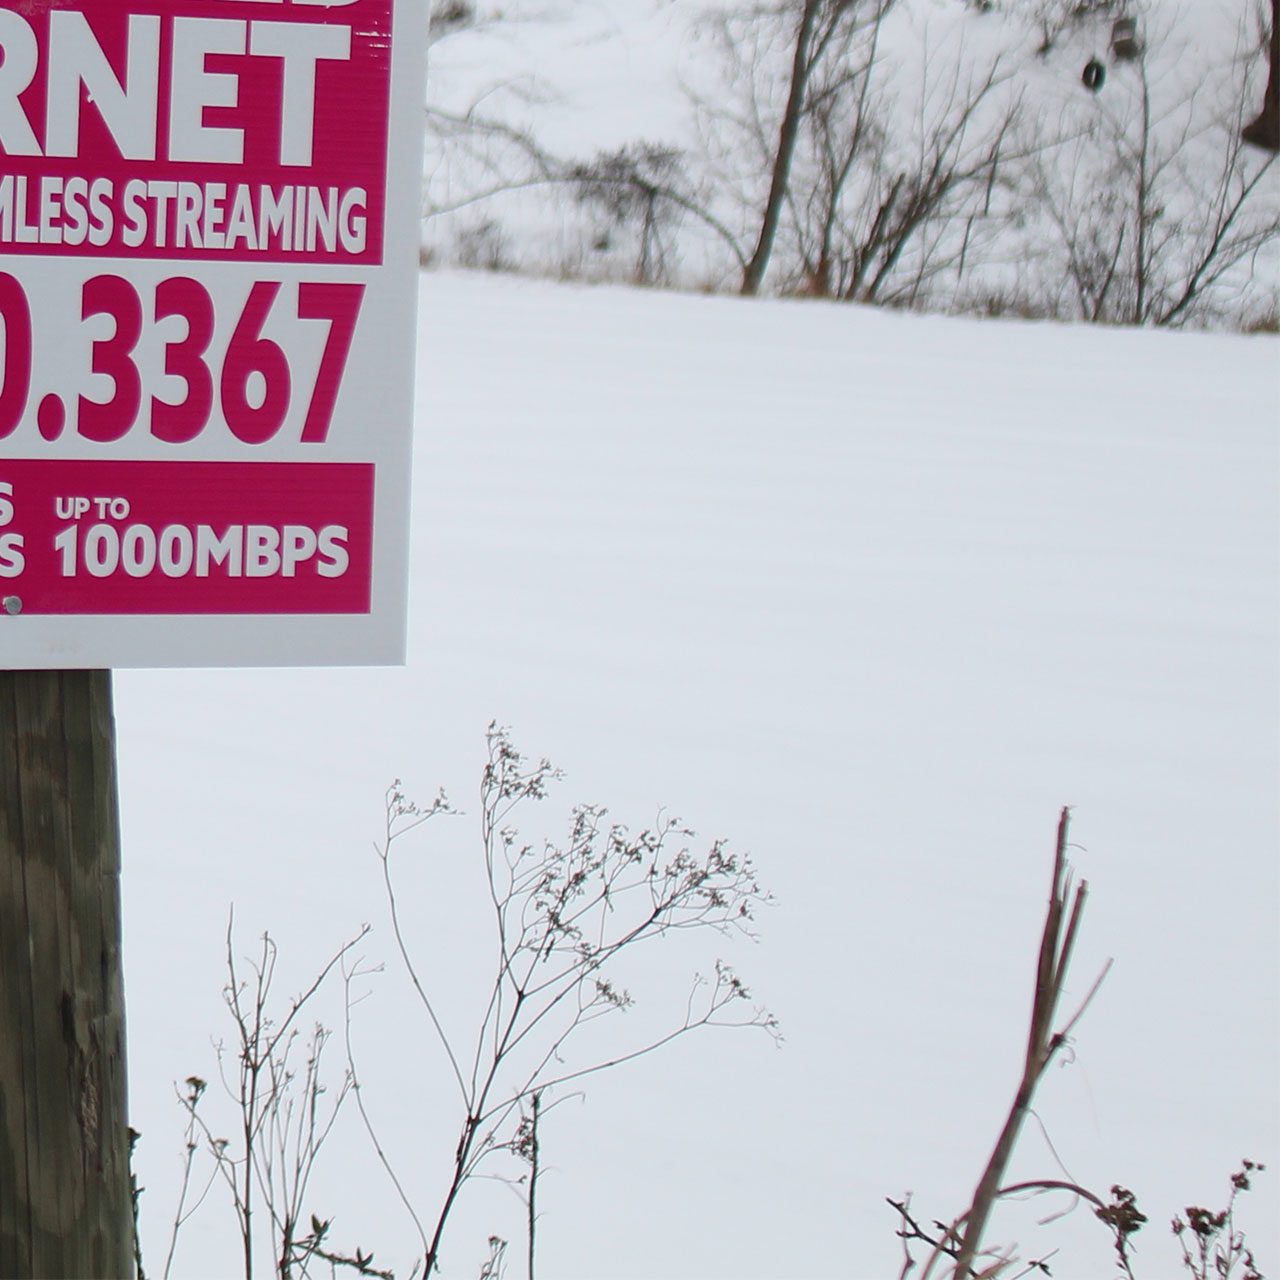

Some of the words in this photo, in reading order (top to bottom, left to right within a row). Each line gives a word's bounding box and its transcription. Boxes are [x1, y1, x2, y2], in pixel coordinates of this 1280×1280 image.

[122, 178, 367, 254] STREAMING
[55, 496, 91, 520] UP
[93, 497, 130, 520] TO
[54, 523, 350, 578] 1000MBPS
